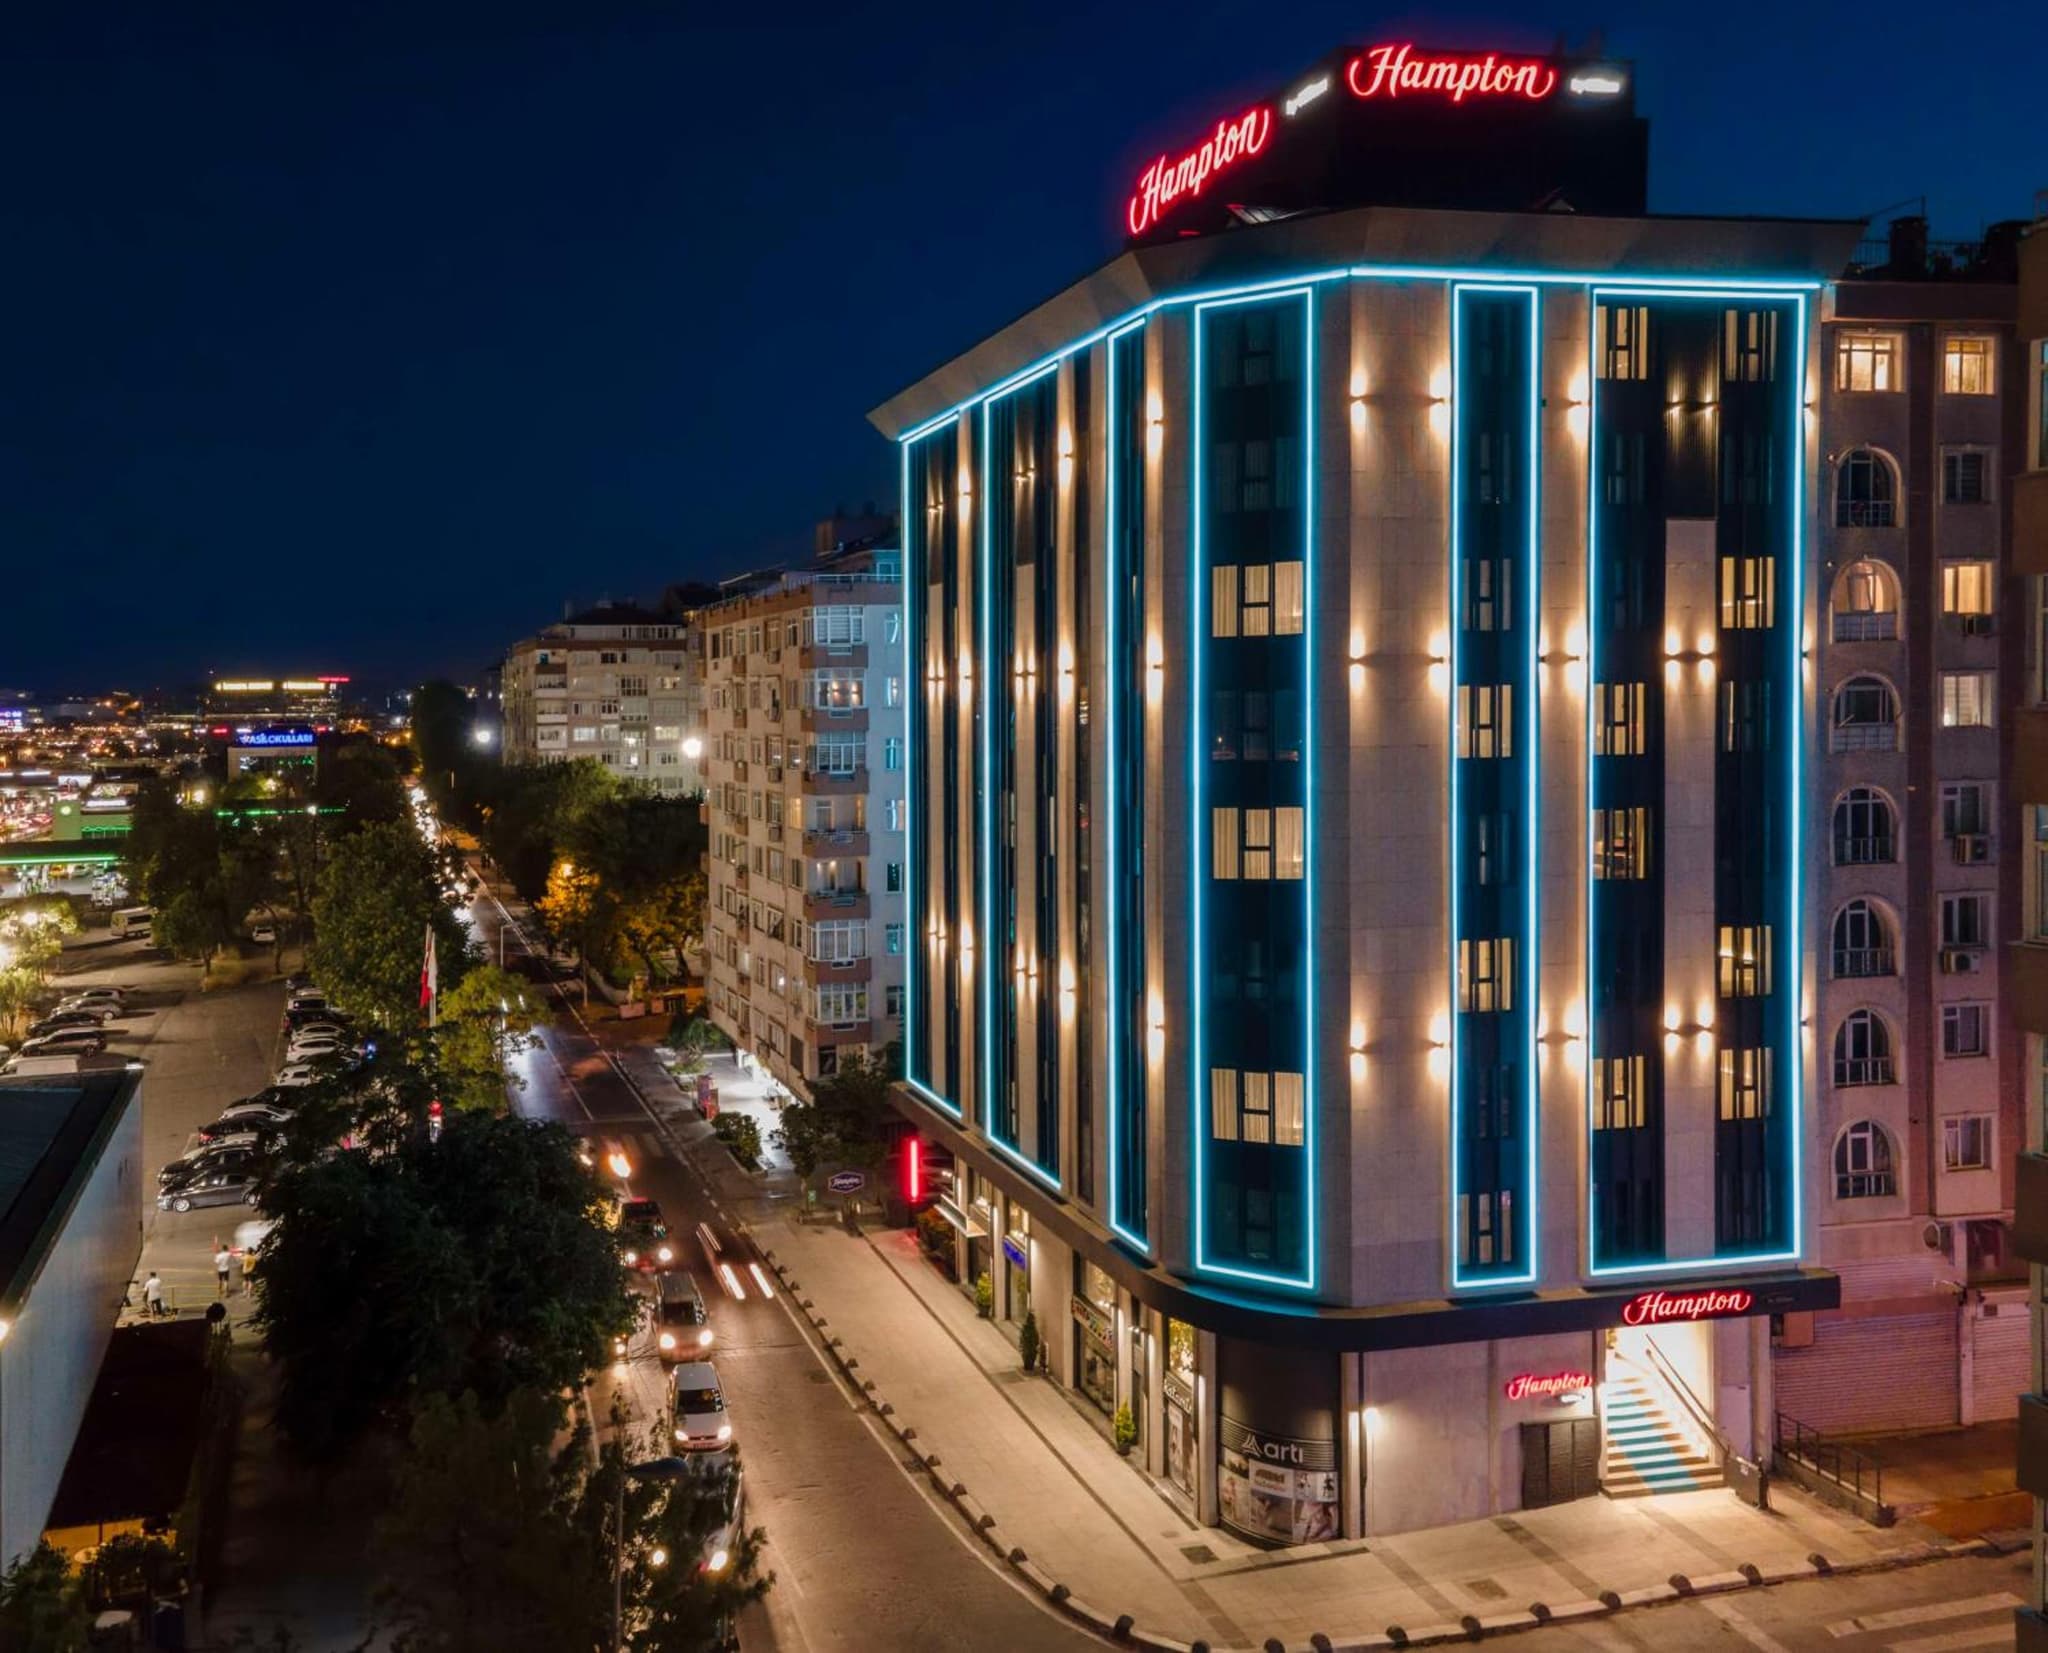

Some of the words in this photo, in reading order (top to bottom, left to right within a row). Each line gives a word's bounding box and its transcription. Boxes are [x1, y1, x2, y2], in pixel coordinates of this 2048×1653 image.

[1349, 44, 1554, 101] Hampton
[1129, 109, 1269, 234] Hampton
[1624, 1291, 1751, 1325] Hampton
[1507, 1374, 1593, 1400] Hampton
